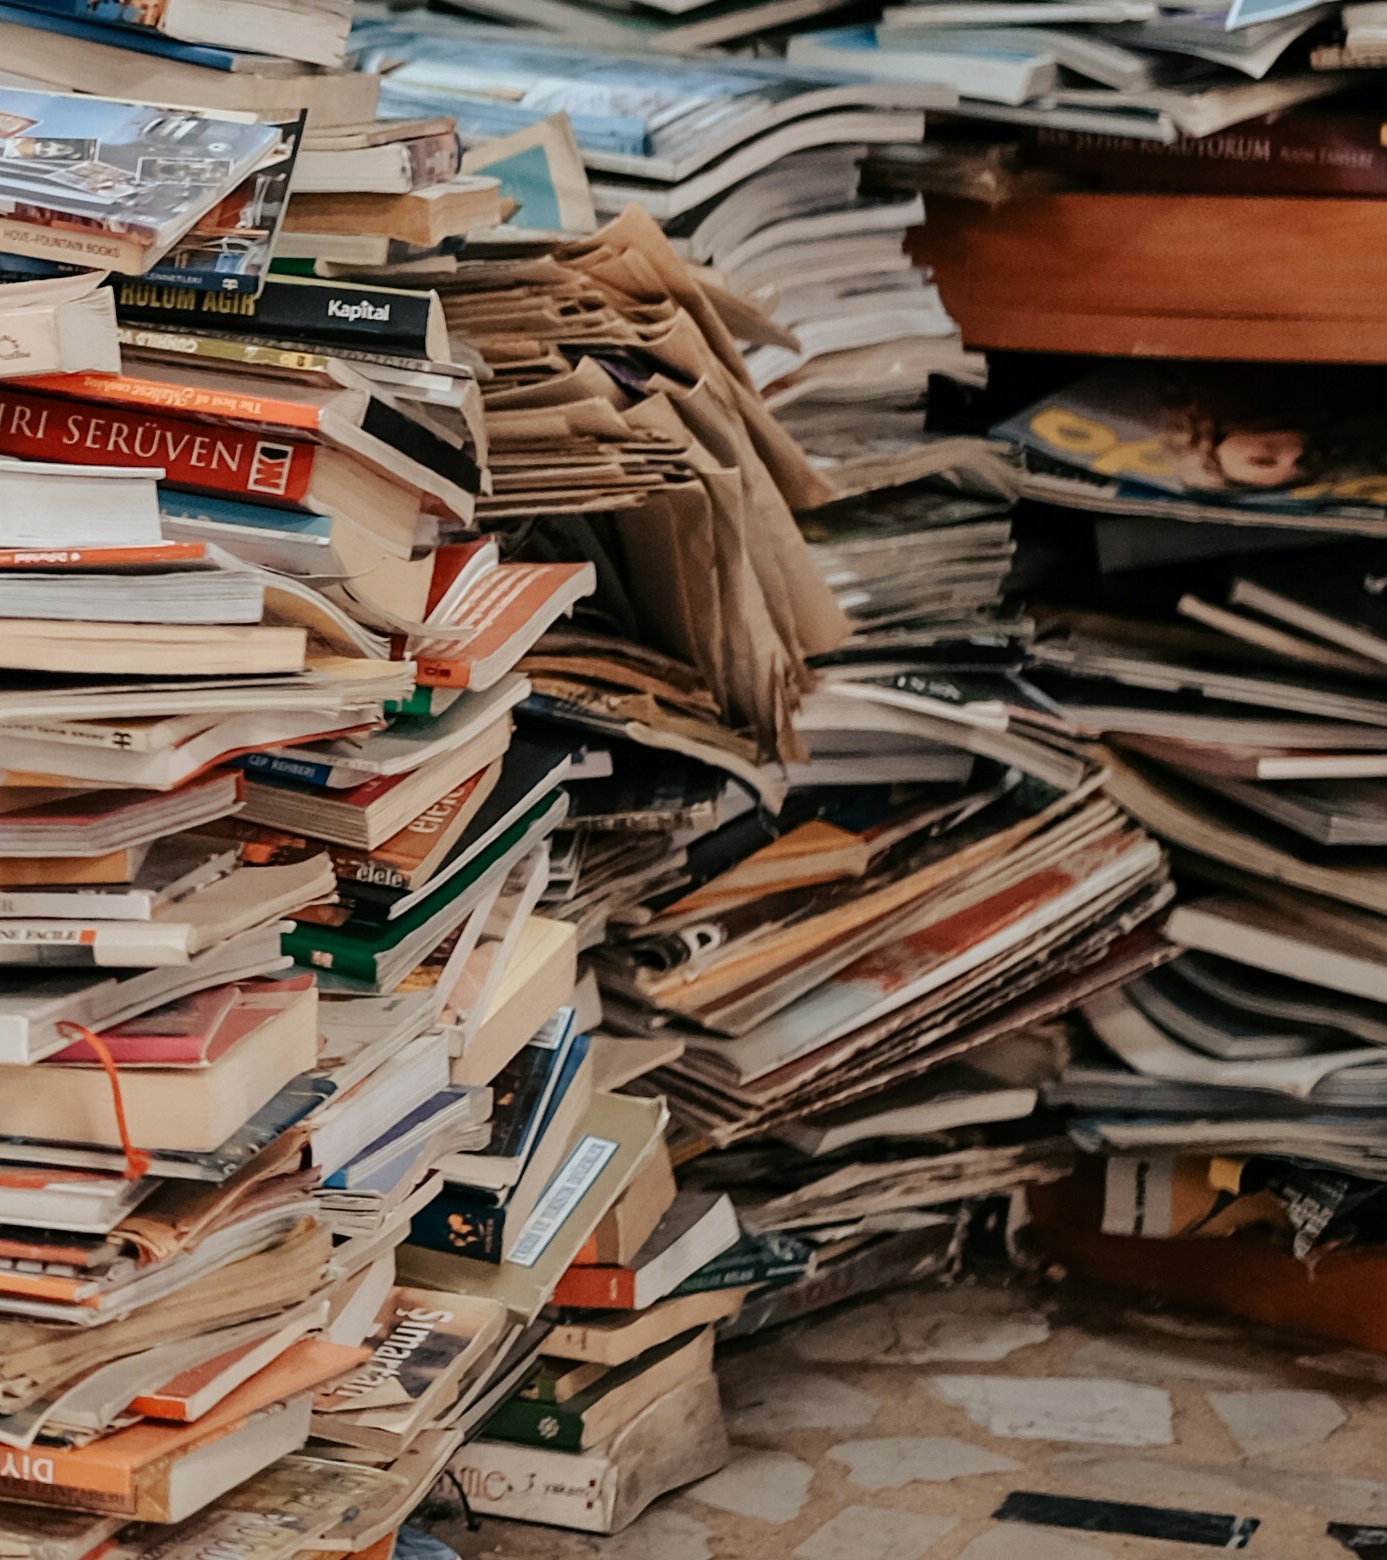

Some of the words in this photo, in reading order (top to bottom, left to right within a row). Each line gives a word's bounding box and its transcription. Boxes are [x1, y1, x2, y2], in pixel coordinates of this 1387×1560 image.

[327, 299, 390, 323] Kapital
[62, 415, 243, 472] SERÜVEN
[247, 753, 270, 771] CEP
[355, 861, 405, 889] elele
[25, 928, 79, 944] FACILE
